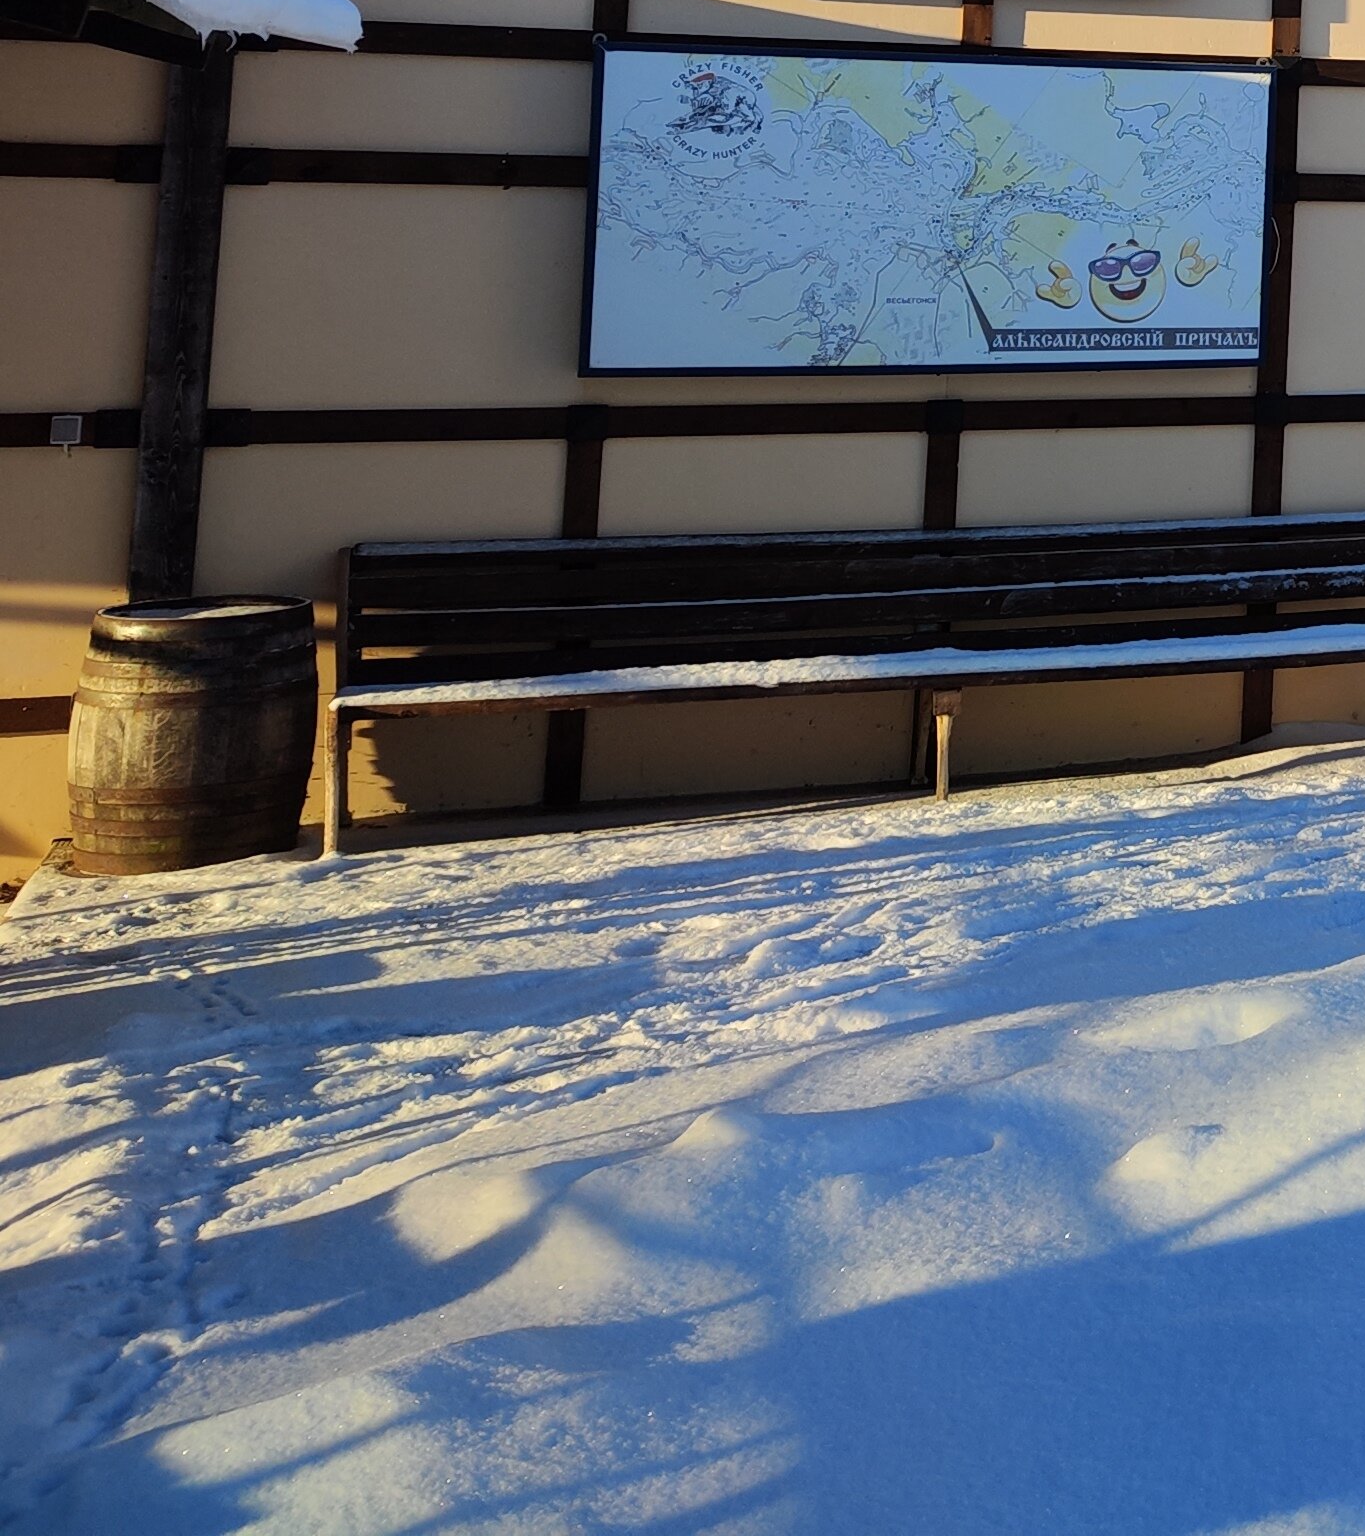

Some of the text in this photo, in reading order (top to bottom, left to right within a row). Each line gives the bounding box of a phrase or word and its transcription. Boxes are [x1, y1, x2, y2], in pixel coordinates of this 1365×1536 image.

[672, 63, 764, 92] CRAZY FISHER
[672, 135, 757, 160] CRAZY HUNTER
[1174, 331, 1258, 347] ПРИЧАЛЪ
